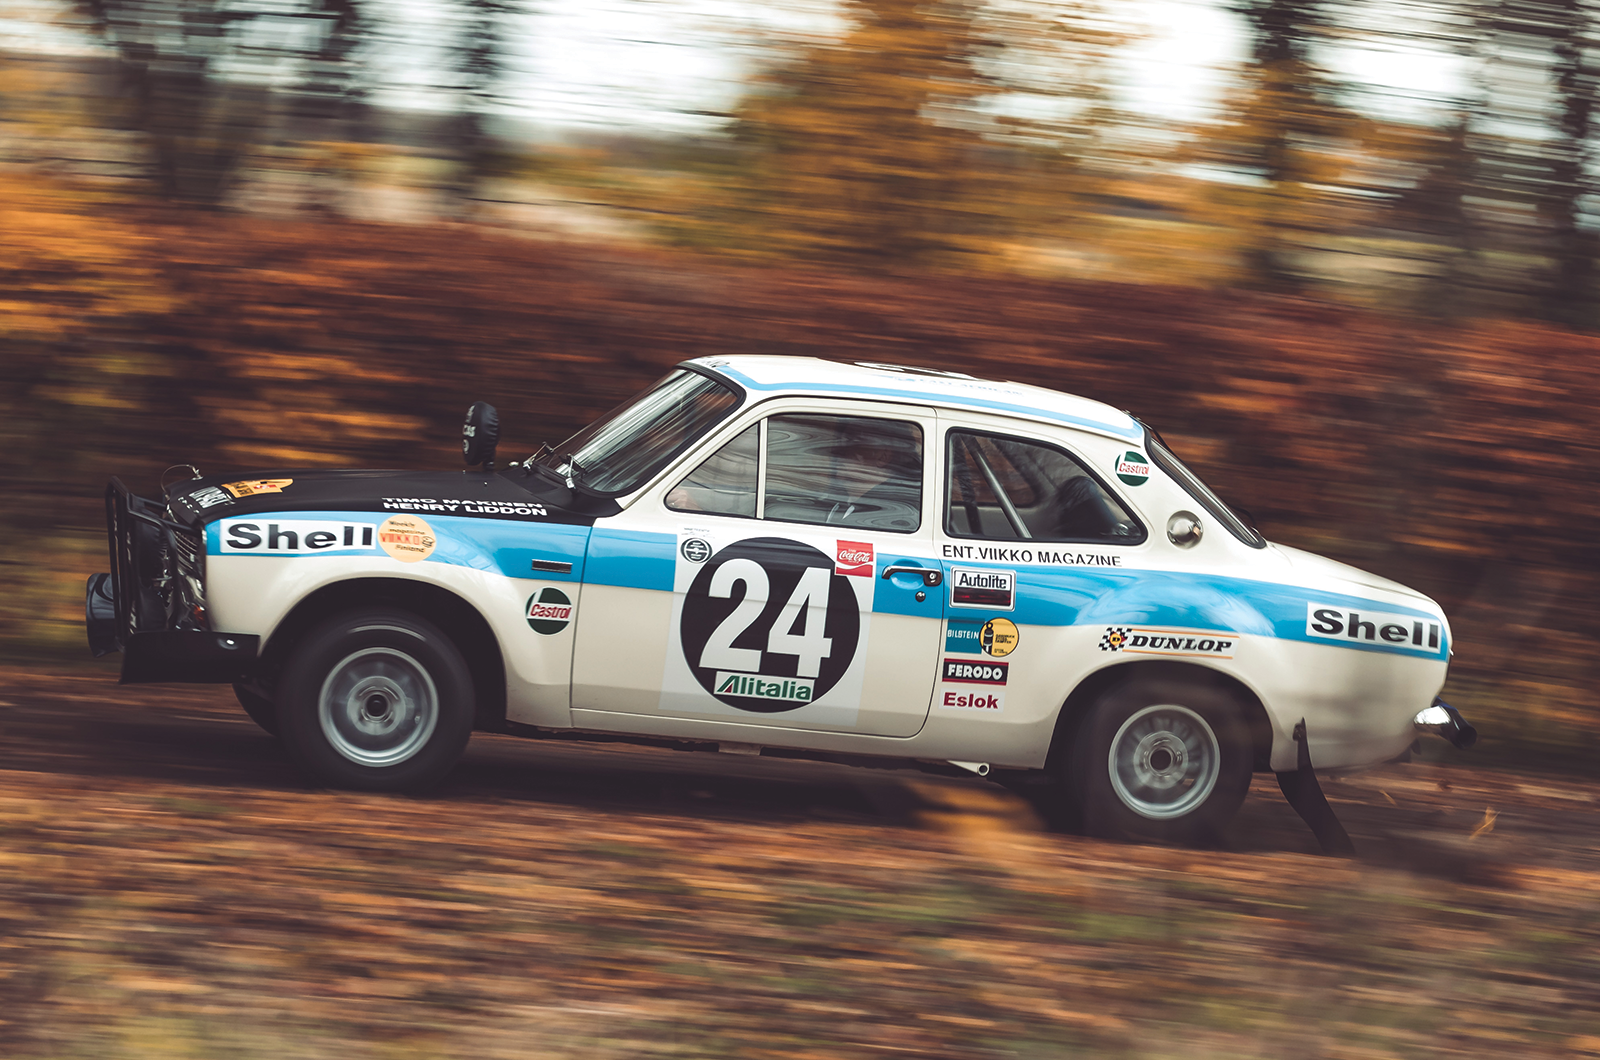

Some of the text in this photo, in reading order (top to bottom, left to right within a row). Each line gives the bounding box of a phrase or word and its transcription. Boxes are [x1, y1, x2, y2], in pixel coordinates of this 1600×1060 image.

[1118, 462, 1149, 475] Castrol
[383, 502, 548, 516] HENRY LIDDON
[225, 523, 373, 550] Shell
[1038, 551, 1122, 567] MAGAZINE
[959, 573, 1007, 589] Autolite
[530, 603, 572, 619] Castrol
[698, 558, 833, 678] 24
[947, 629, 979, 639] BILSTEIN
[1311, 608, 1439, 650] Shell
[1129, 635, 1232, 652] DUNLOP
[947, 663, 1003, 681] FERODO
[717, 675, 812, 701] Alitalia
[943, 692, 999, 709] Eslok
